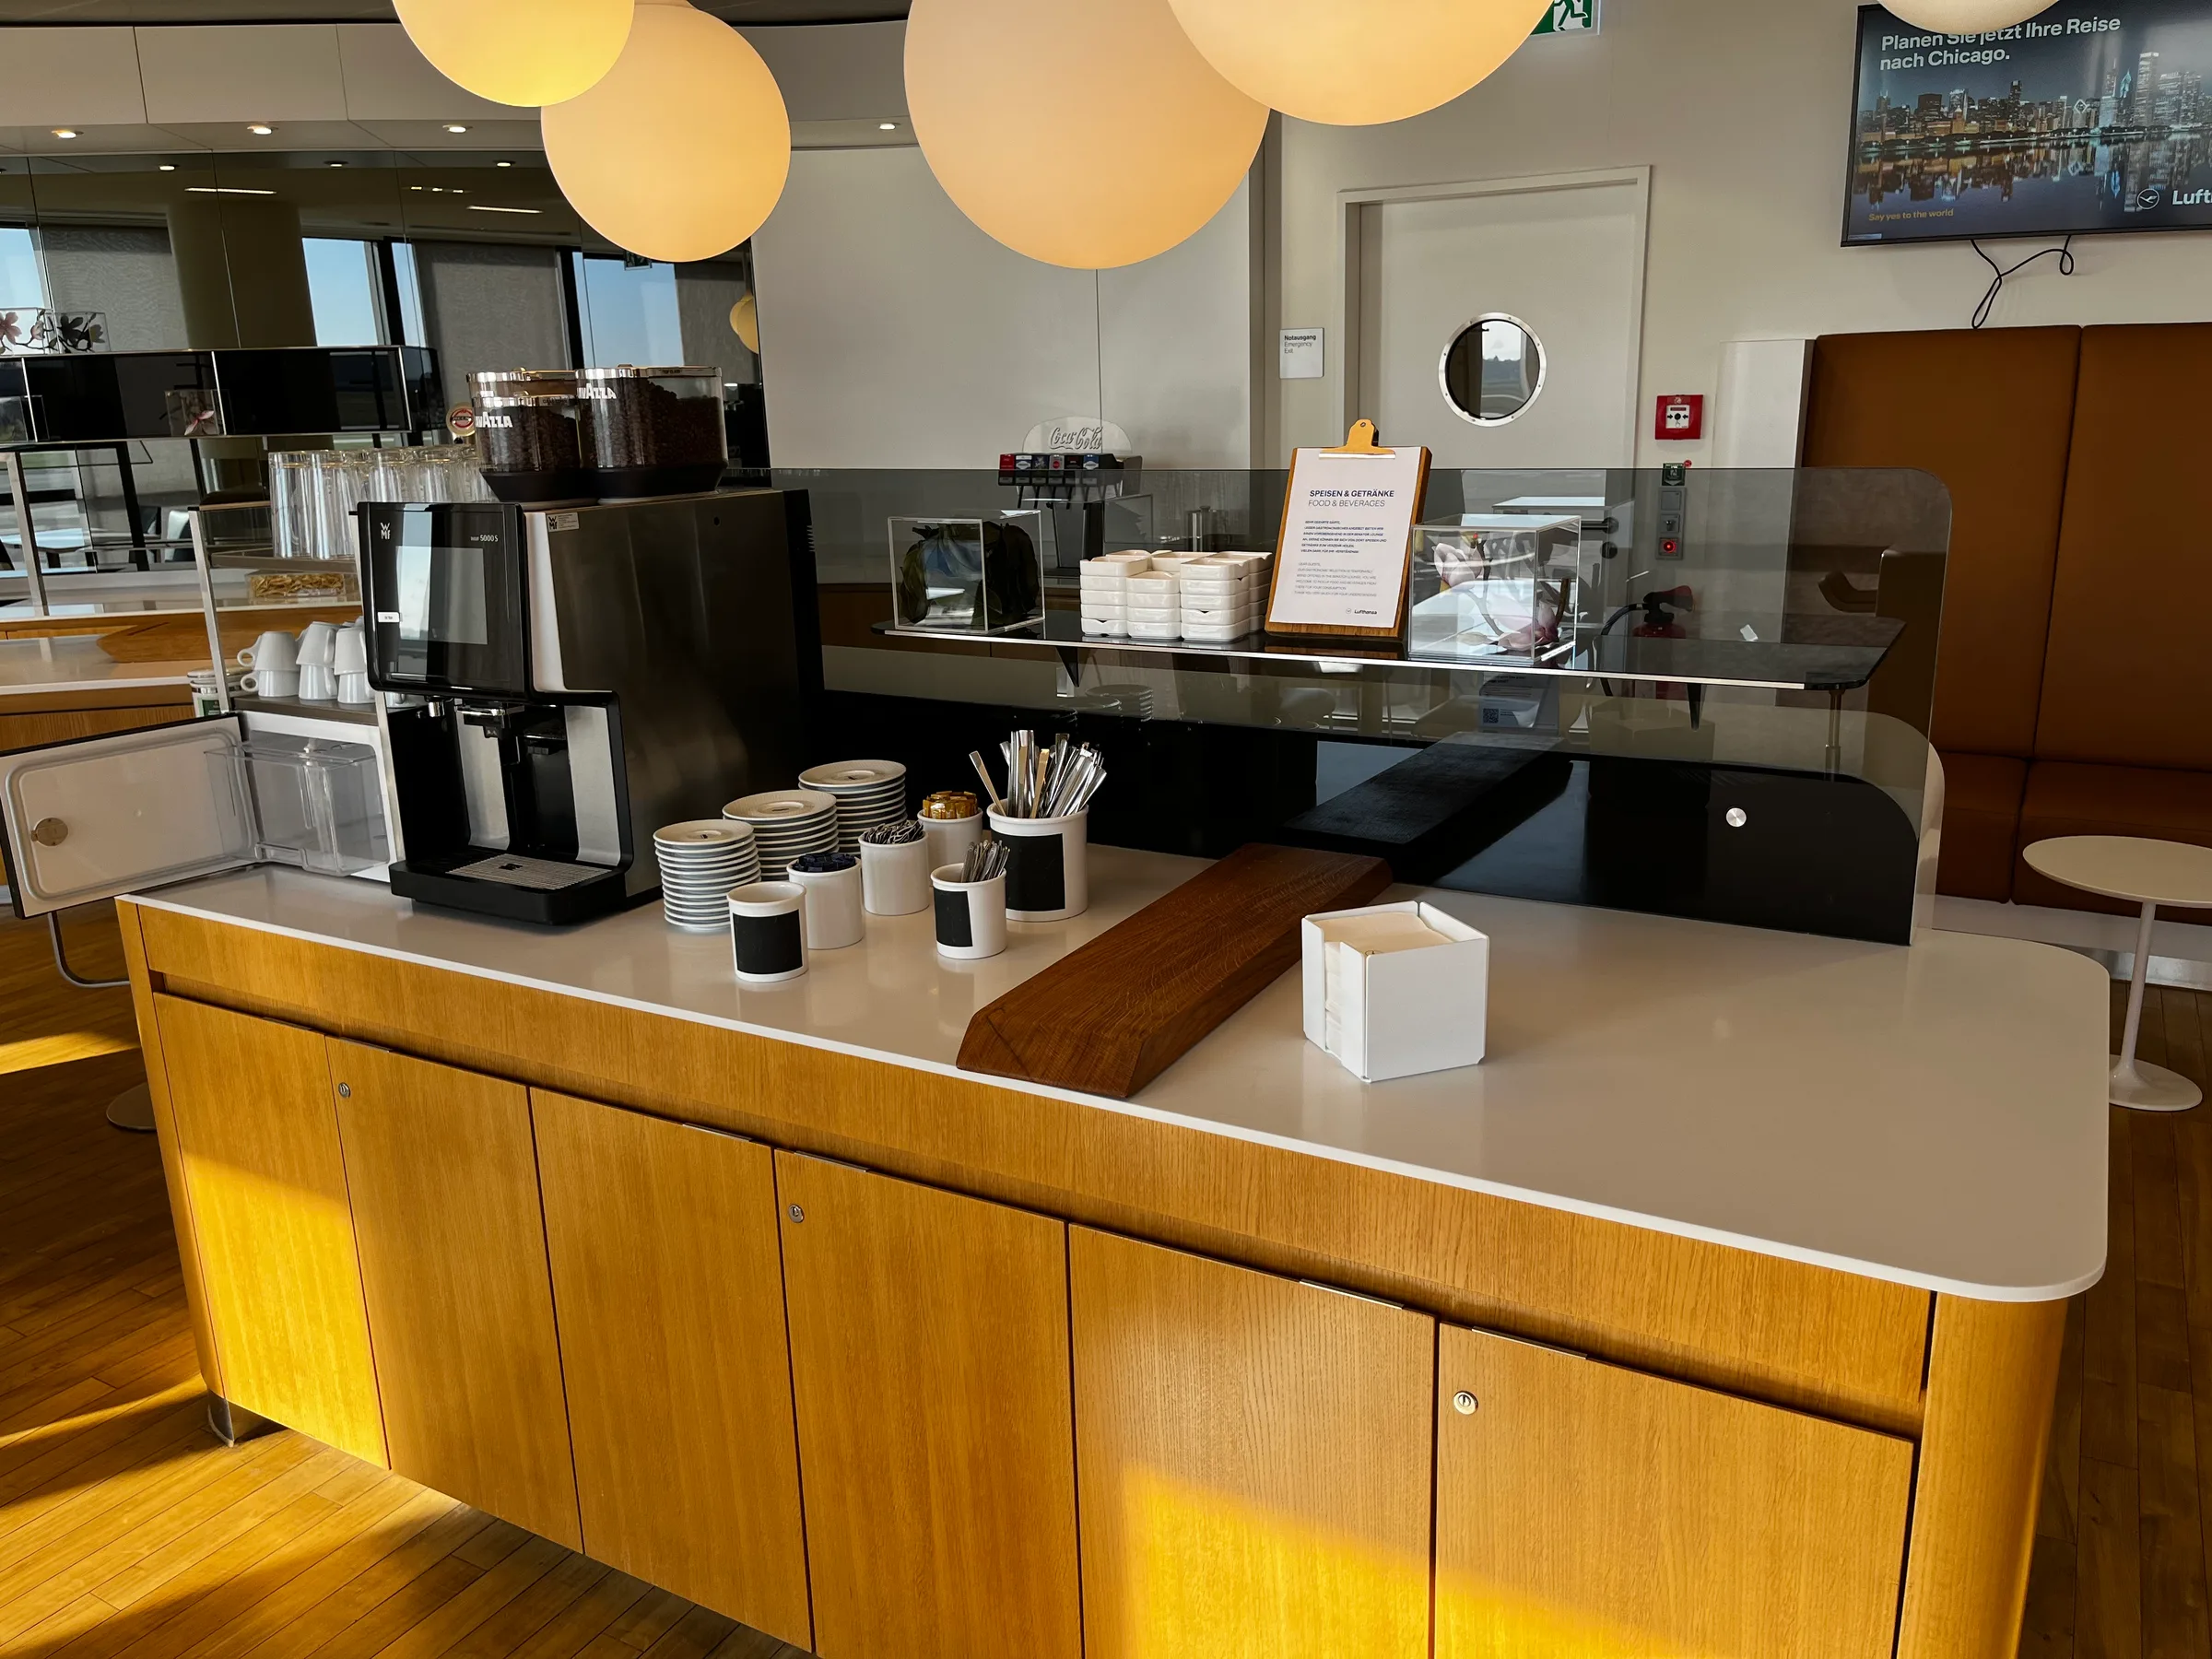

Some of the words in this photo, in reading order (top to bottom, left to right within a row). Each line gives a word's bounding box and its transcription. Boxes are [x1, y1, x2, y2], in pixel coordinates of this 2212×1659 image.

[1881, 33, 1943, 51] Planen
[2026, 22, 2063, 39] Ihre
[2066, 17, 2121, 35] Reise
[1880, 53, 1924, 70] nach
[1927, 48, 2010, 66] Chicago.
[2172, 188, 2212, 206] Luft
[1868, 213, 1886, 222] Say
[1887, 213, 1900, 221] yes
[1902, 211, 1912, 219] to
[1913, 210, 1927, 218] the
[1929, 208, 1954, 218] world
[1351, 488, 1395, 497] GETRÄNKE
